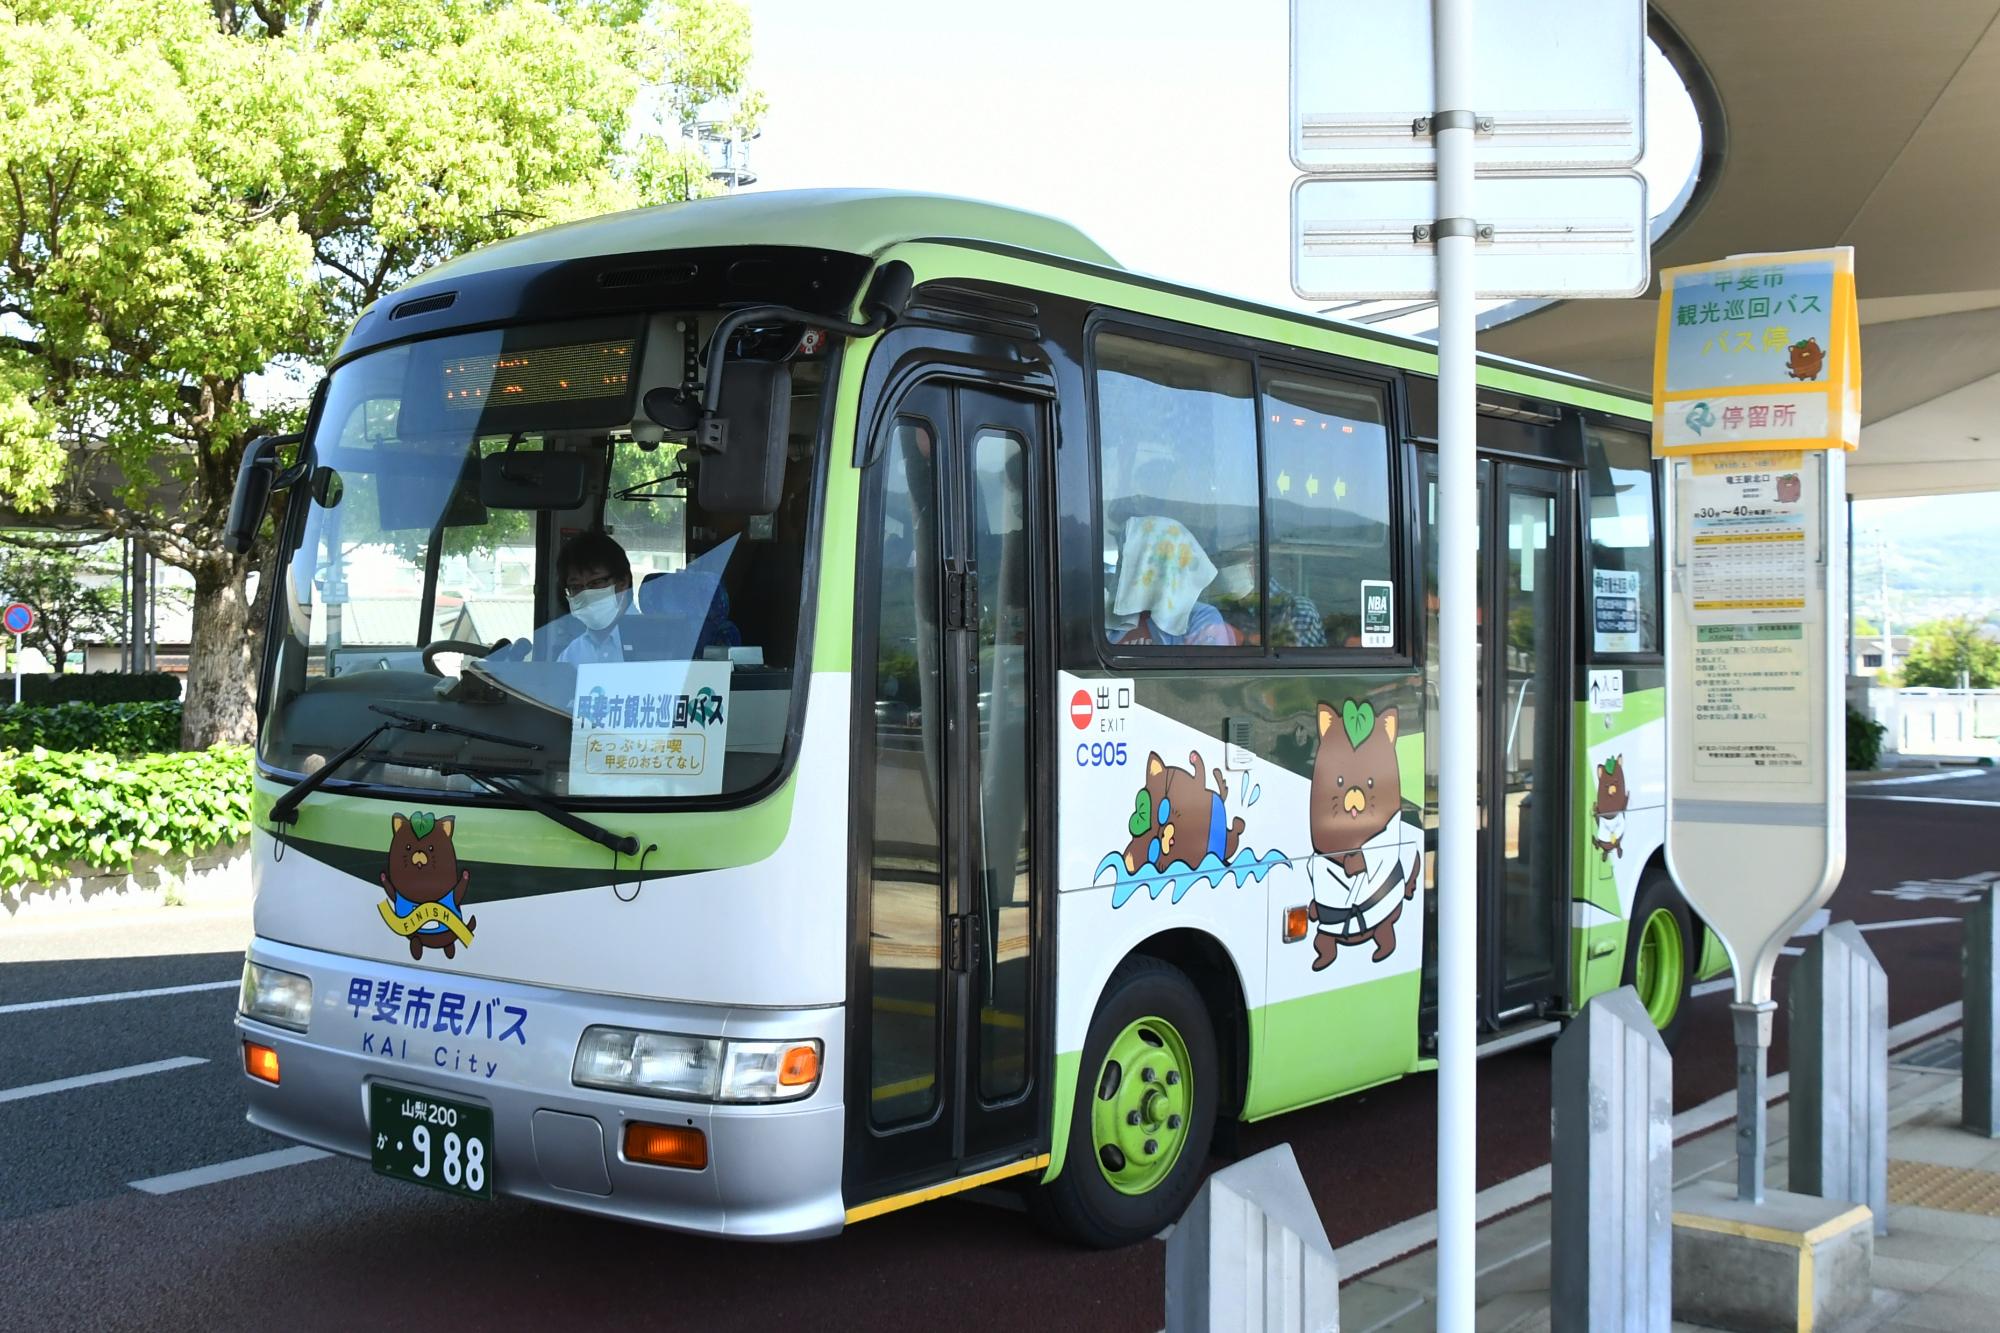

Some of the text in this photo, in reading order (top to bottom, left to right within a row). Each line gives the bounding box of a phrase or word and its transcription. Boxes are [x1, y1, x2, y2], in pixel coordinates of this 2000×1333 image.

[1713, 267, 1785, 293] 甲斐市
[1677, 295, 1822, 327] 観光巡回バス
[1702, 326, 1790, 355] バス停
[1721, 403, 1797, 430] 停留所
[1367, 596, 1387, 611] NBA
[577, 693, 724, 729] 甲斐市観光巡回バス
[1097, 686, 1130, 710] 出口
[1100, 718, 1126, 733] EXIT
[604, 754, 700, 769] 甲斐のおもてなし
[1076, 741, 1128, 767] C905
[403, 907, 450, 932] FINISH
[347, 977, 528, 1046] 甲斐市民バス
[362, 1032, 498, 1078] KAI City
